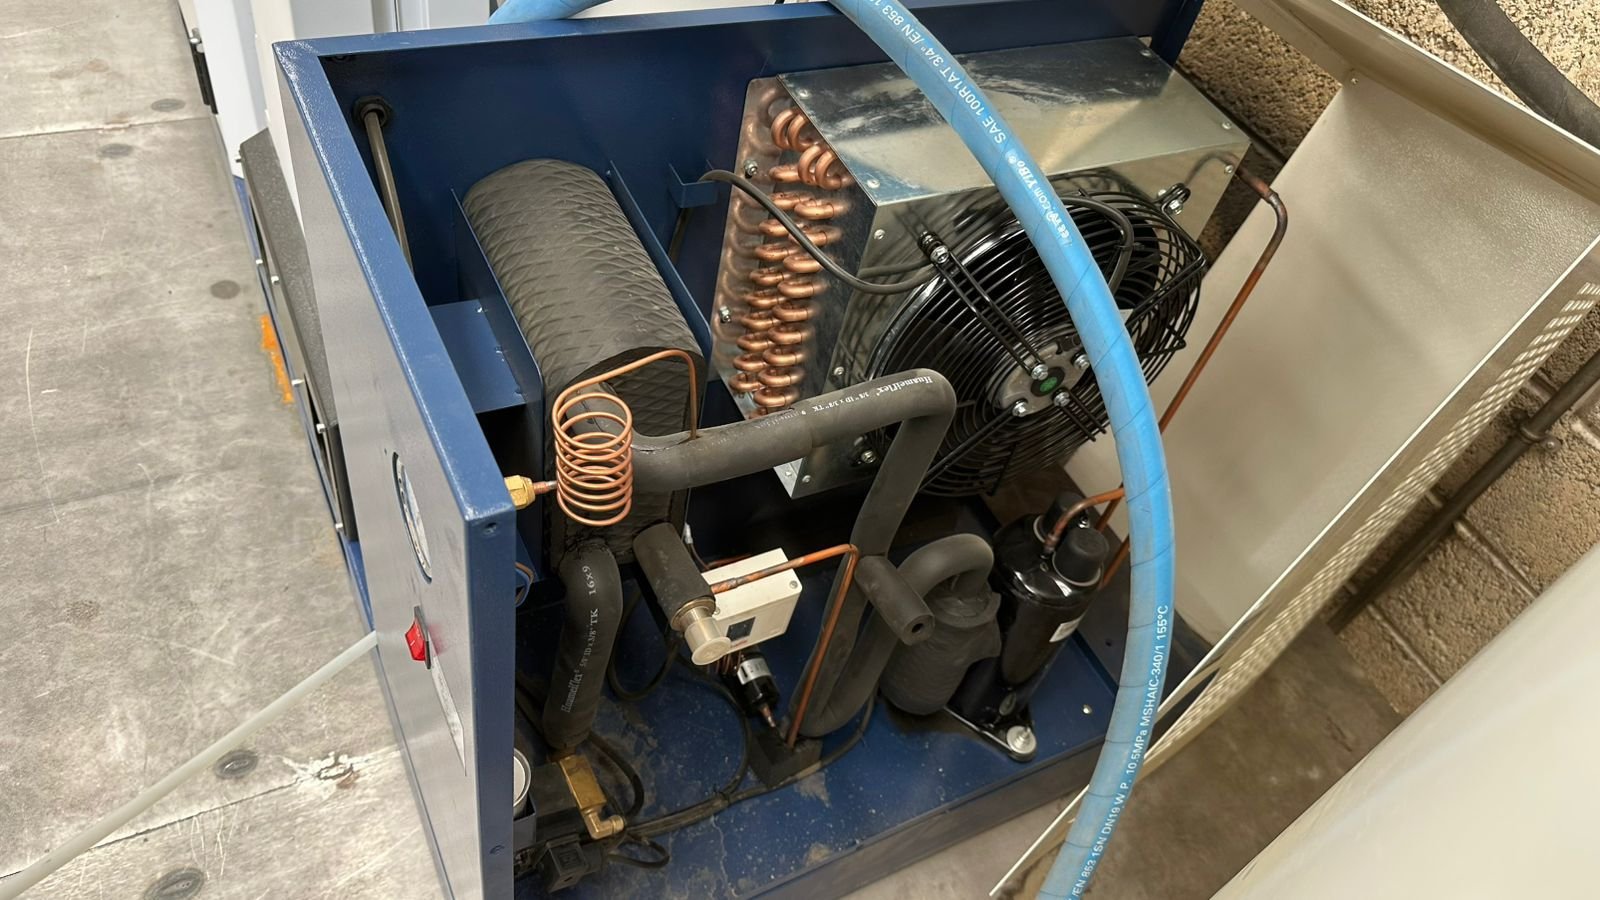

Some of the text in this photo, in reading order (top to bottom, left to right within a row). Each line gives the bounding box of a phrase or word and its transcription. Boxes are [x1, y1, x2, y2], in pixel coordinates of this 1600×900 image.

[882, 4, 904, 26] 853
[901, 23, 925, 45] /EN
[939, 66, 985, 116] 100R1AT
[982, 115, 1007, 144] SAE
[812, 404, 825, 413] TK
[590, 608, 598, 625] TK
[1081, 859, 1096, 877] 853
[1091, 836, 1107, 857] 1SN
[1101, 806, 1121, 834] DN19
[1126, 729, 1148, 775] 10.5MPa
[1156, 604, 1169, 641] 155°C
